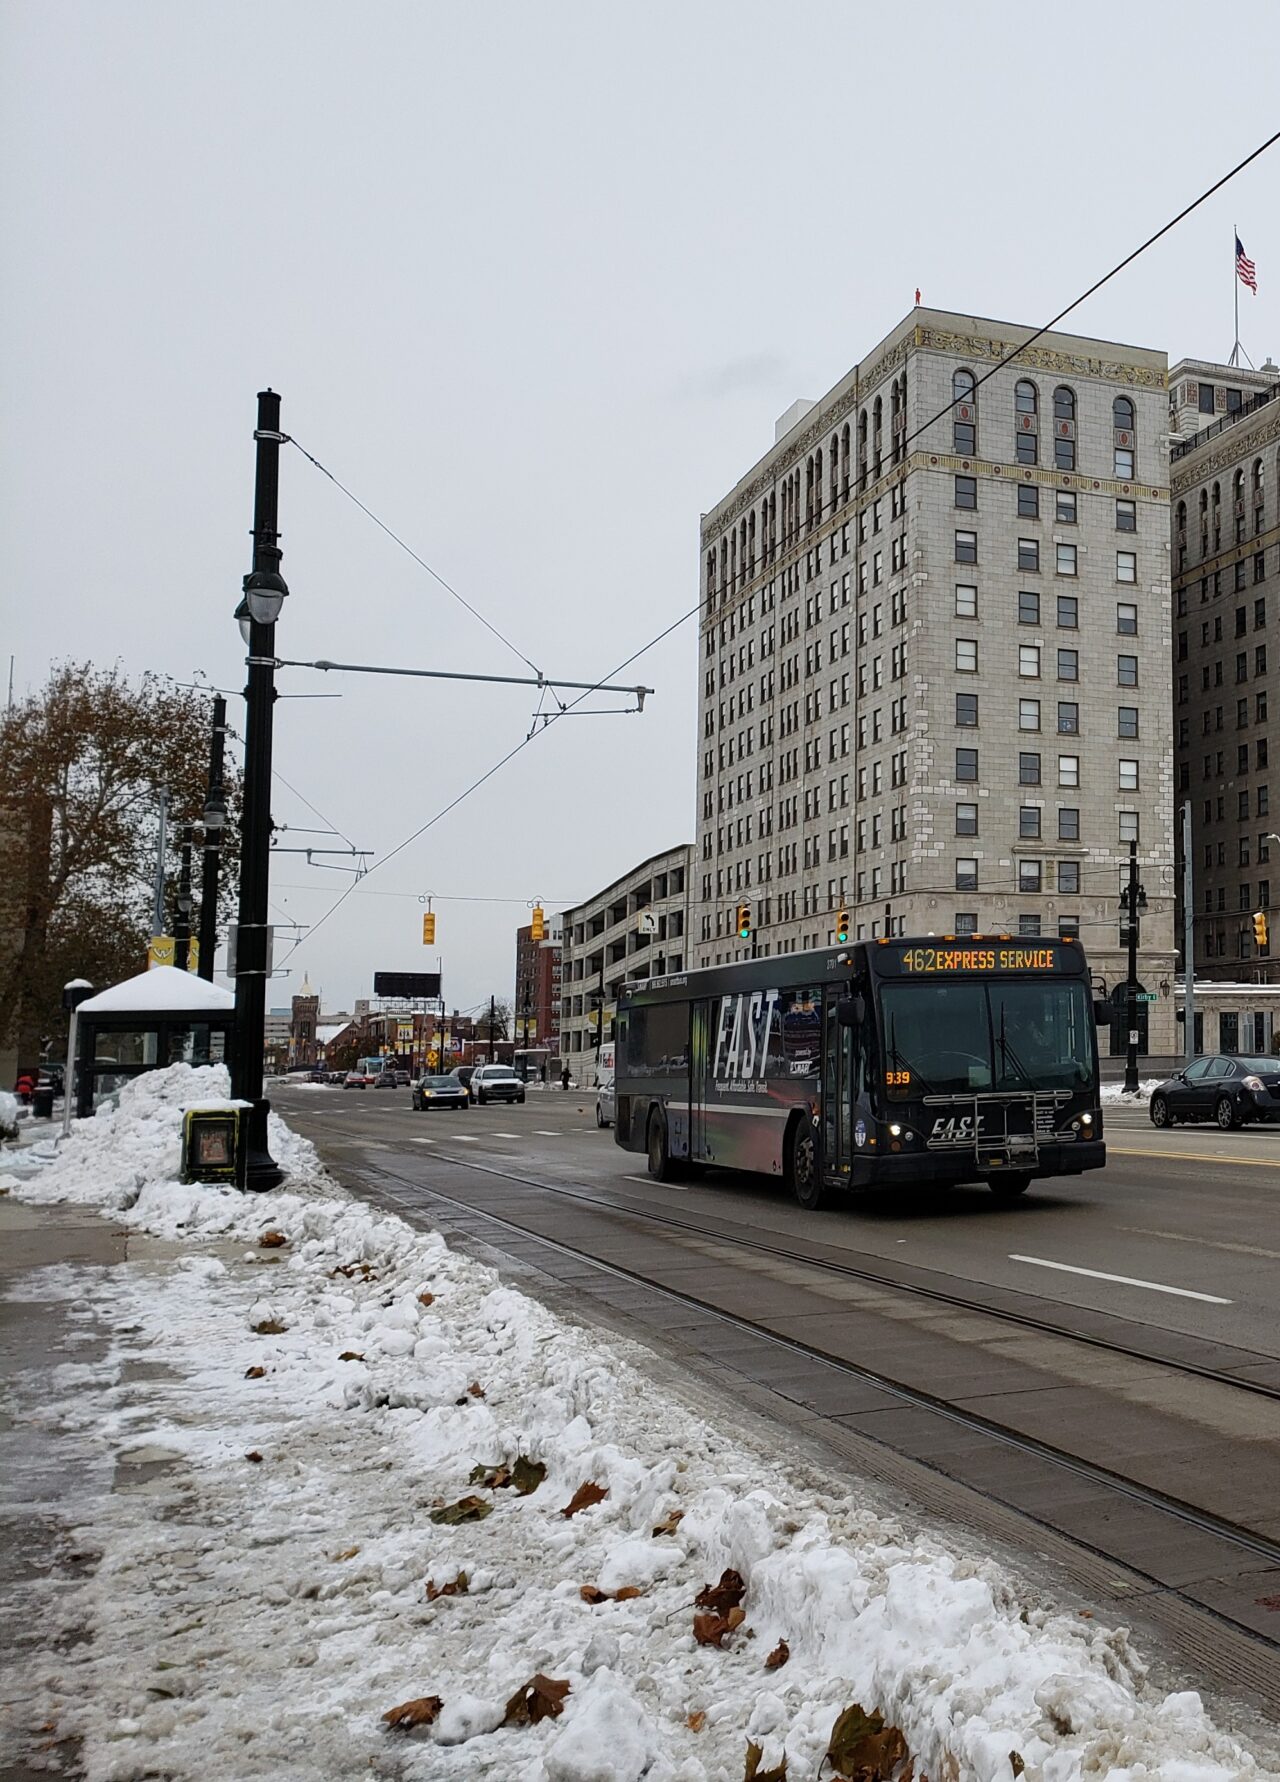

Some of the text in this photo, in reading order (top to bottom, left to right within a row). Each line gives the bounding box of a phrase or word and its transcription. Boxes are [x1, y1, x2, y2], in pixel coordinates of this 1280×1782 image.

[903, 949, 1054, 972] 462 EXPRESS SERVICE
[713, 988, 778, 1078] FAST
[931, 1116, 985, 1138] FAST
